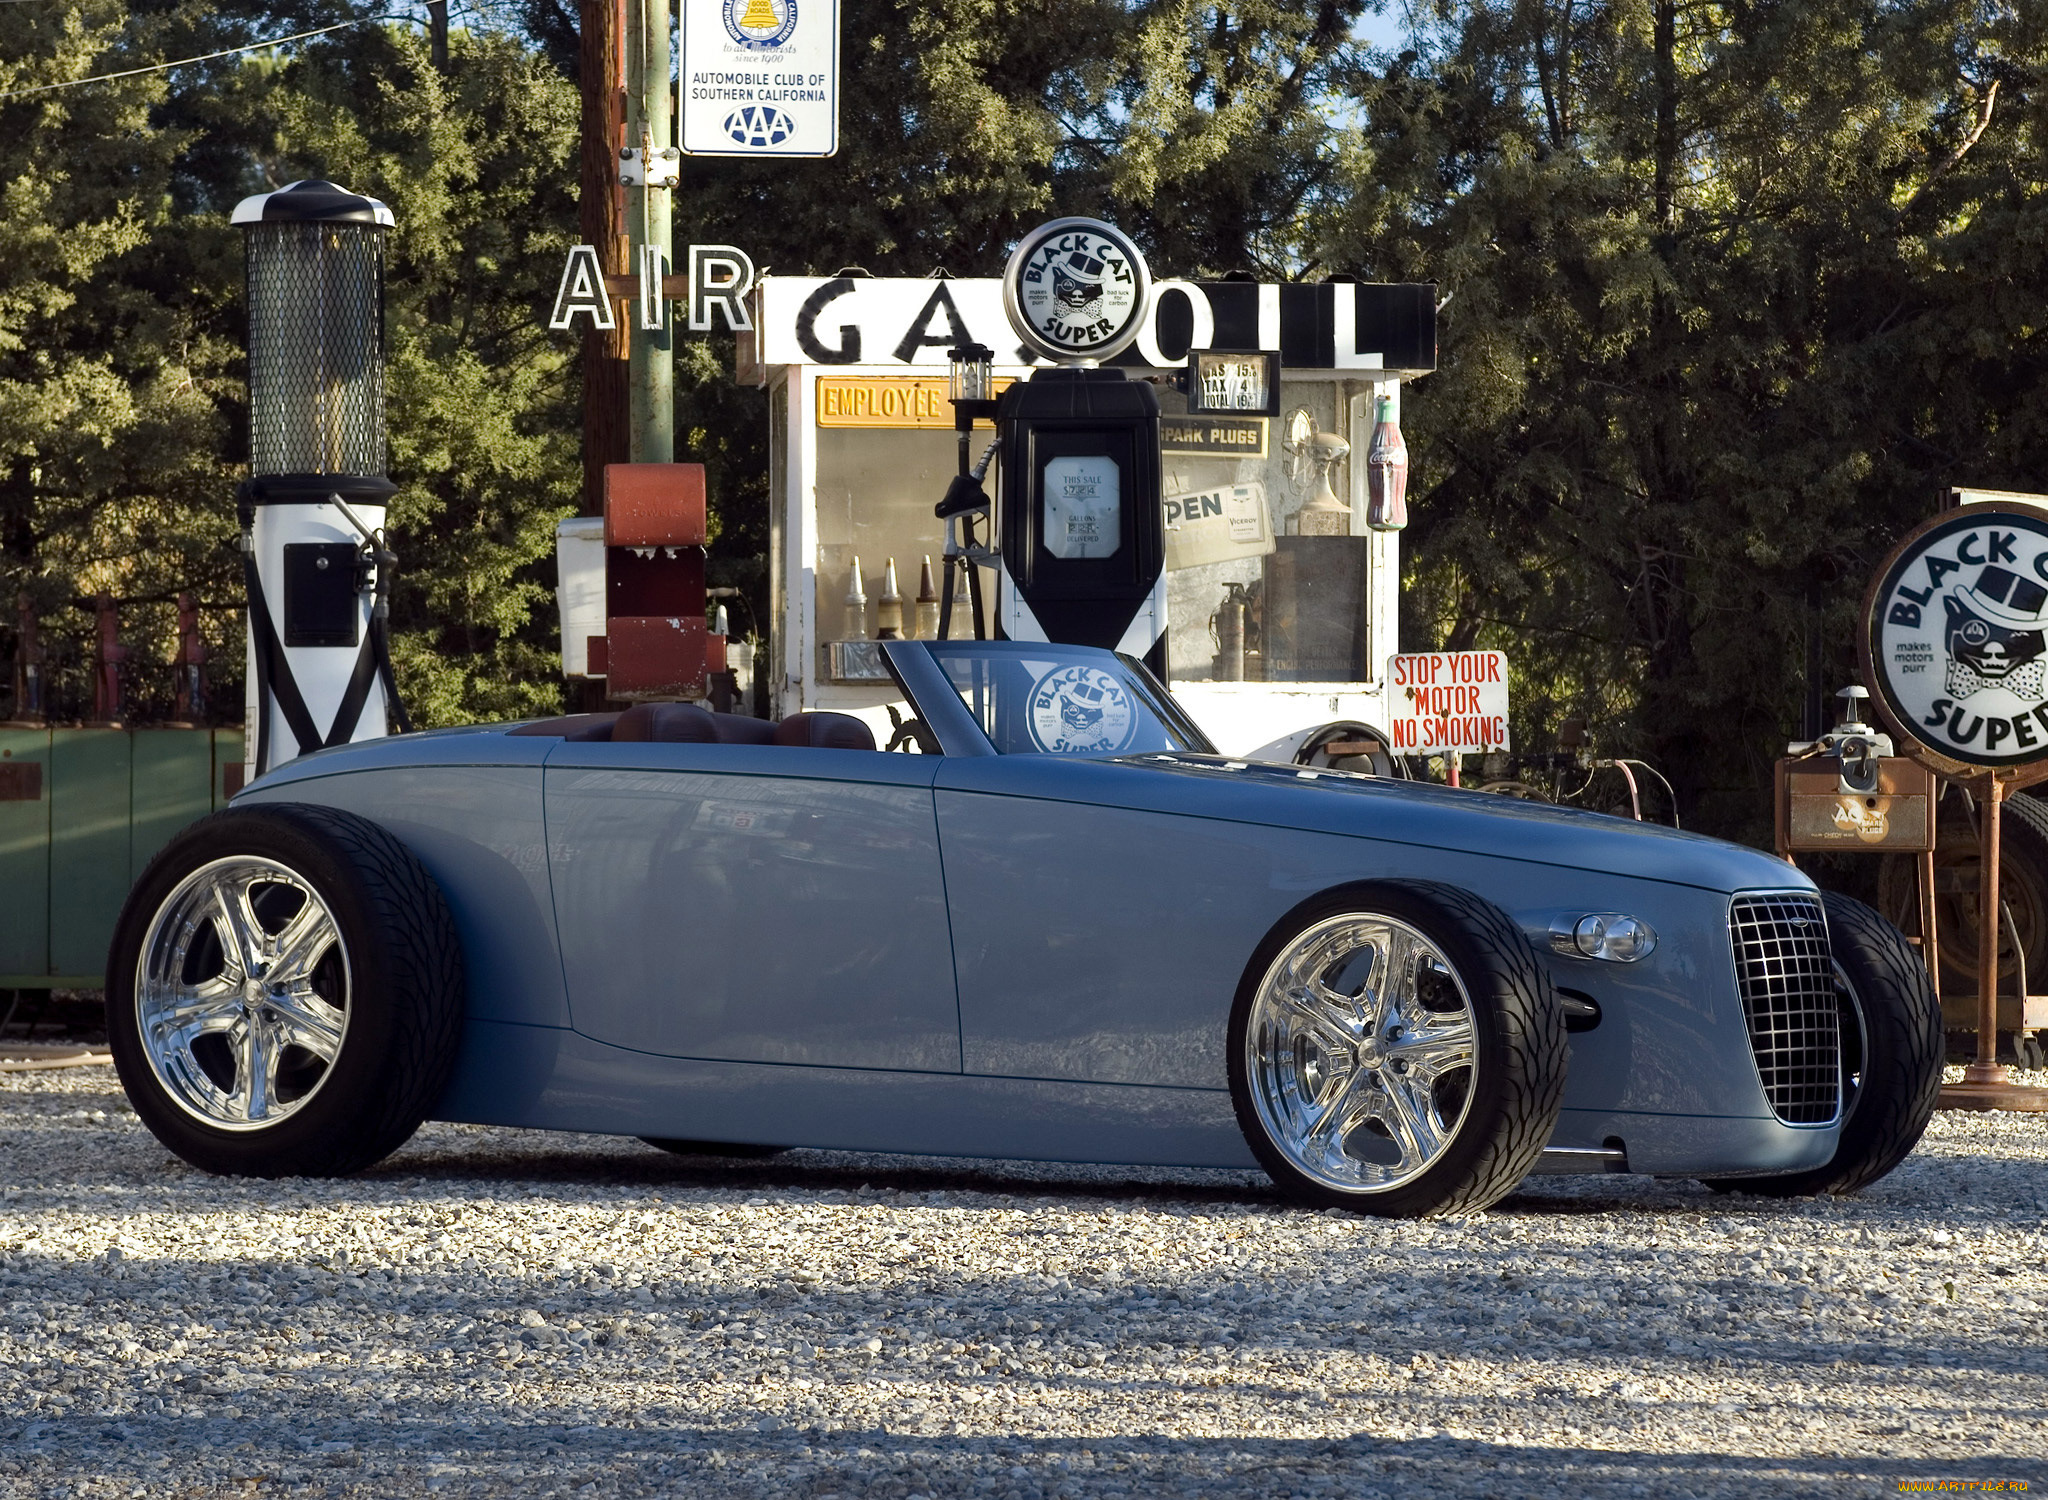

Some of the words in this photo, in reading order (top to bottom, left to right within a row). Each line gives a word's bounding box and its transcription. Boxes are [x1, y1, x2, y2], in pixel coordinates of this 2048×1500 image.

[776, 2, 796, 42] CALIFORNIA
[761, 55, 784, 65] 1900
[693, 72, 769, 85] AUTOMOBILE
[774, 74, 803, 85] CLUB
[808, 74, 825, 85] OF
[692, 88, 753, 100] SOUTHERN
[758, 89, 826, 101] CALIFORNIA
[724, 104, 794, 147] AAA
[1025, 235, 1089, 284] BLACK
[1097, 245, 1132, 285] CAT
[549, 244, 755, 331] AIR
[1043, 318, 1114, 343] SUPER
[1205, 379, 1226, 392] TAX
[1241, 379, 1248, 392] 4
[824, 386, 942, 417] EMPLOYEE
[1206, 394, 1229, 407] TOTAL
[1210, 428, 1257, 444] PLUGS
[1064, 475, 1081, 484] THIS
[1083, 475, 1102, 484] SALE
[1163, 493, 1223, 524] PEN
[1229, 517, 1257, 526] VICEROY
[1888, 531, 2017, 629] BLACK
[1894, 653, 1934, 662] motors
[1896, 641, 1932, 651] makes
[1394, 656, 1442, 685] STOP
[1447, 654, 1500, 683] YOUR
[1902, 664, 1926, 674] purr
[1036, 668, 1090, 709] BLACK
[1097, 676, 1127, 709] CAT
[1415, 686, 1481, 716] MOTOR
[1393, 719, 1417, 748] NO
[1423, 716, 1504, 747] SMOKING
